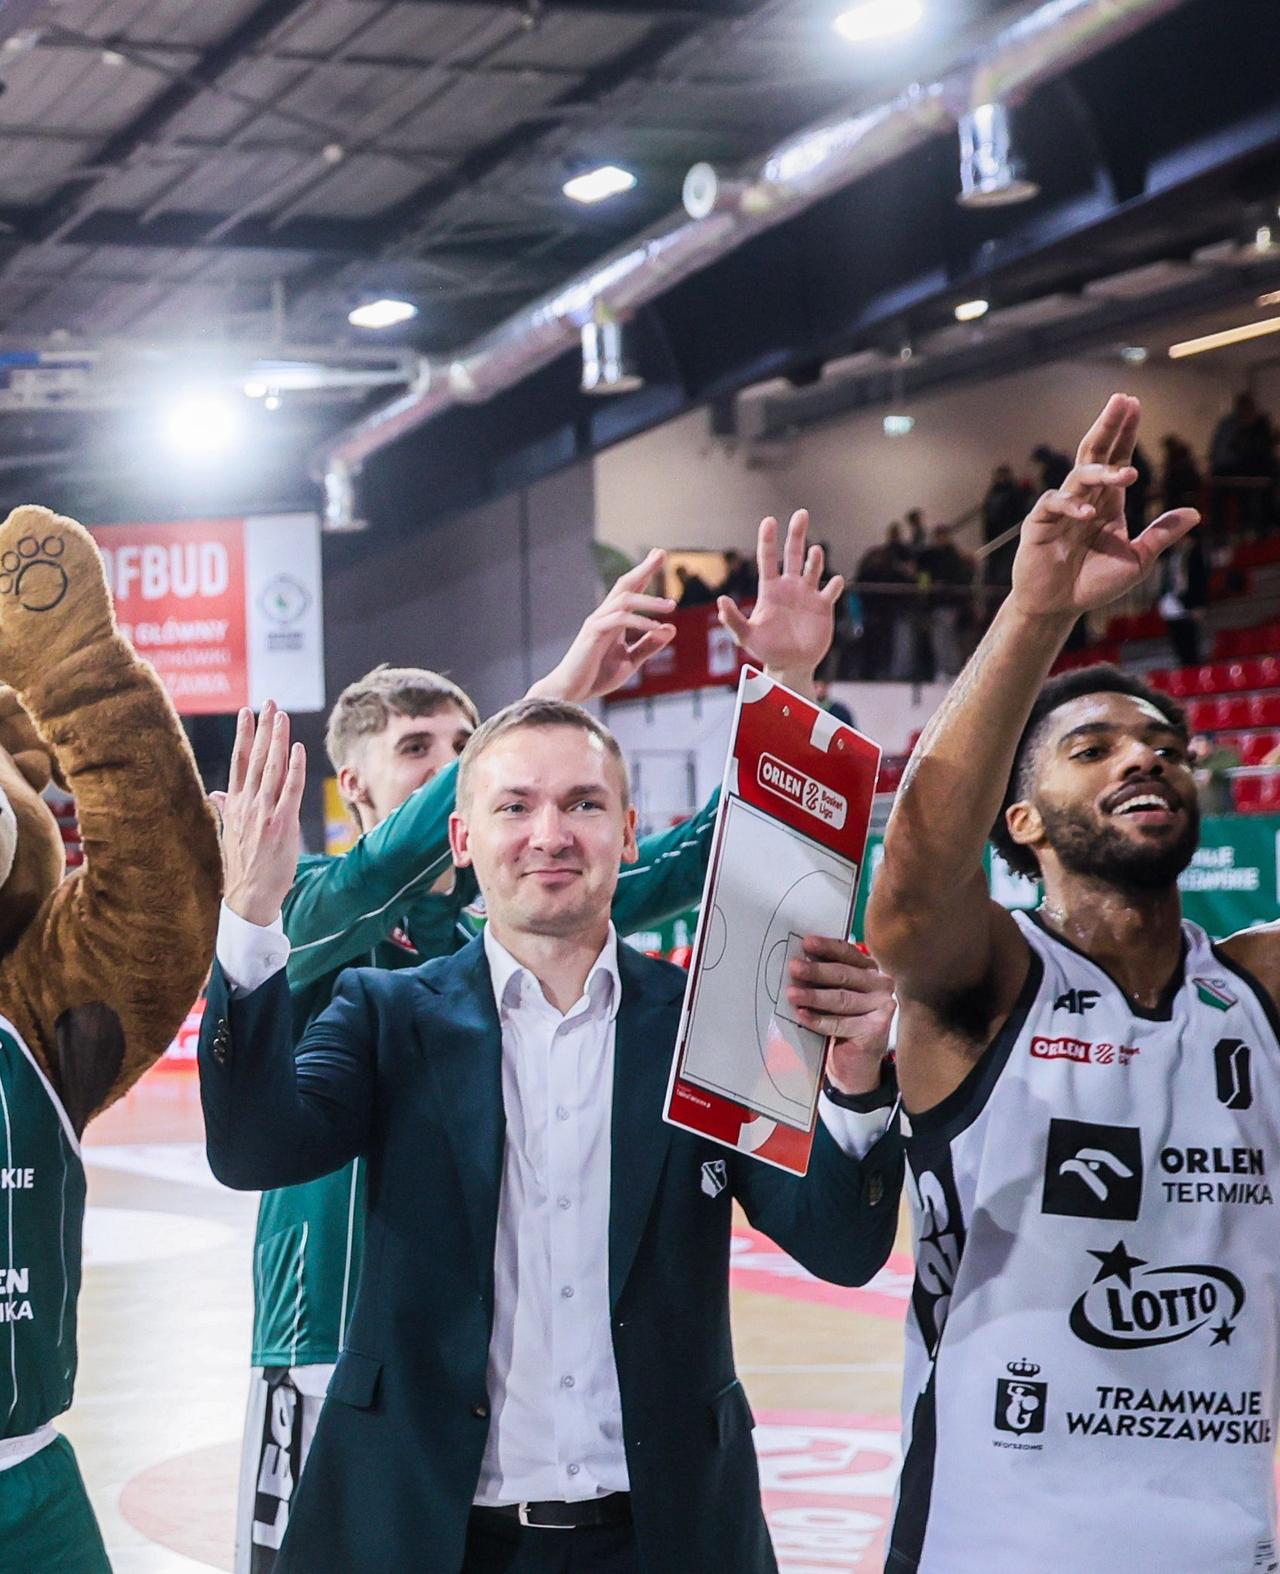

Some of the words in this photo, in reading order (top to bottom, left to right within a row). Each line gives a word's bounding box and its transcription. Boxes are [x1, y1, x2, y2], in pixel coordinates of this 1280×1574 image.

[763, 761, 801, 797] ORLEN
[1034, 1041, 1086, 1059] ORLEN
[1214, 1038, 1253, 1110] 0
[1160, 1147, 1265, 1175] ORLEN
[1162, 1182, 1274, 1205] TERMIKA
[1106, 1282, 1217, 1332] LOTTO
[1096, 1386, 1262, 1415] TRAMWAJE
[1066, 1411, 1271, 1444] WARSZAWSKIE
